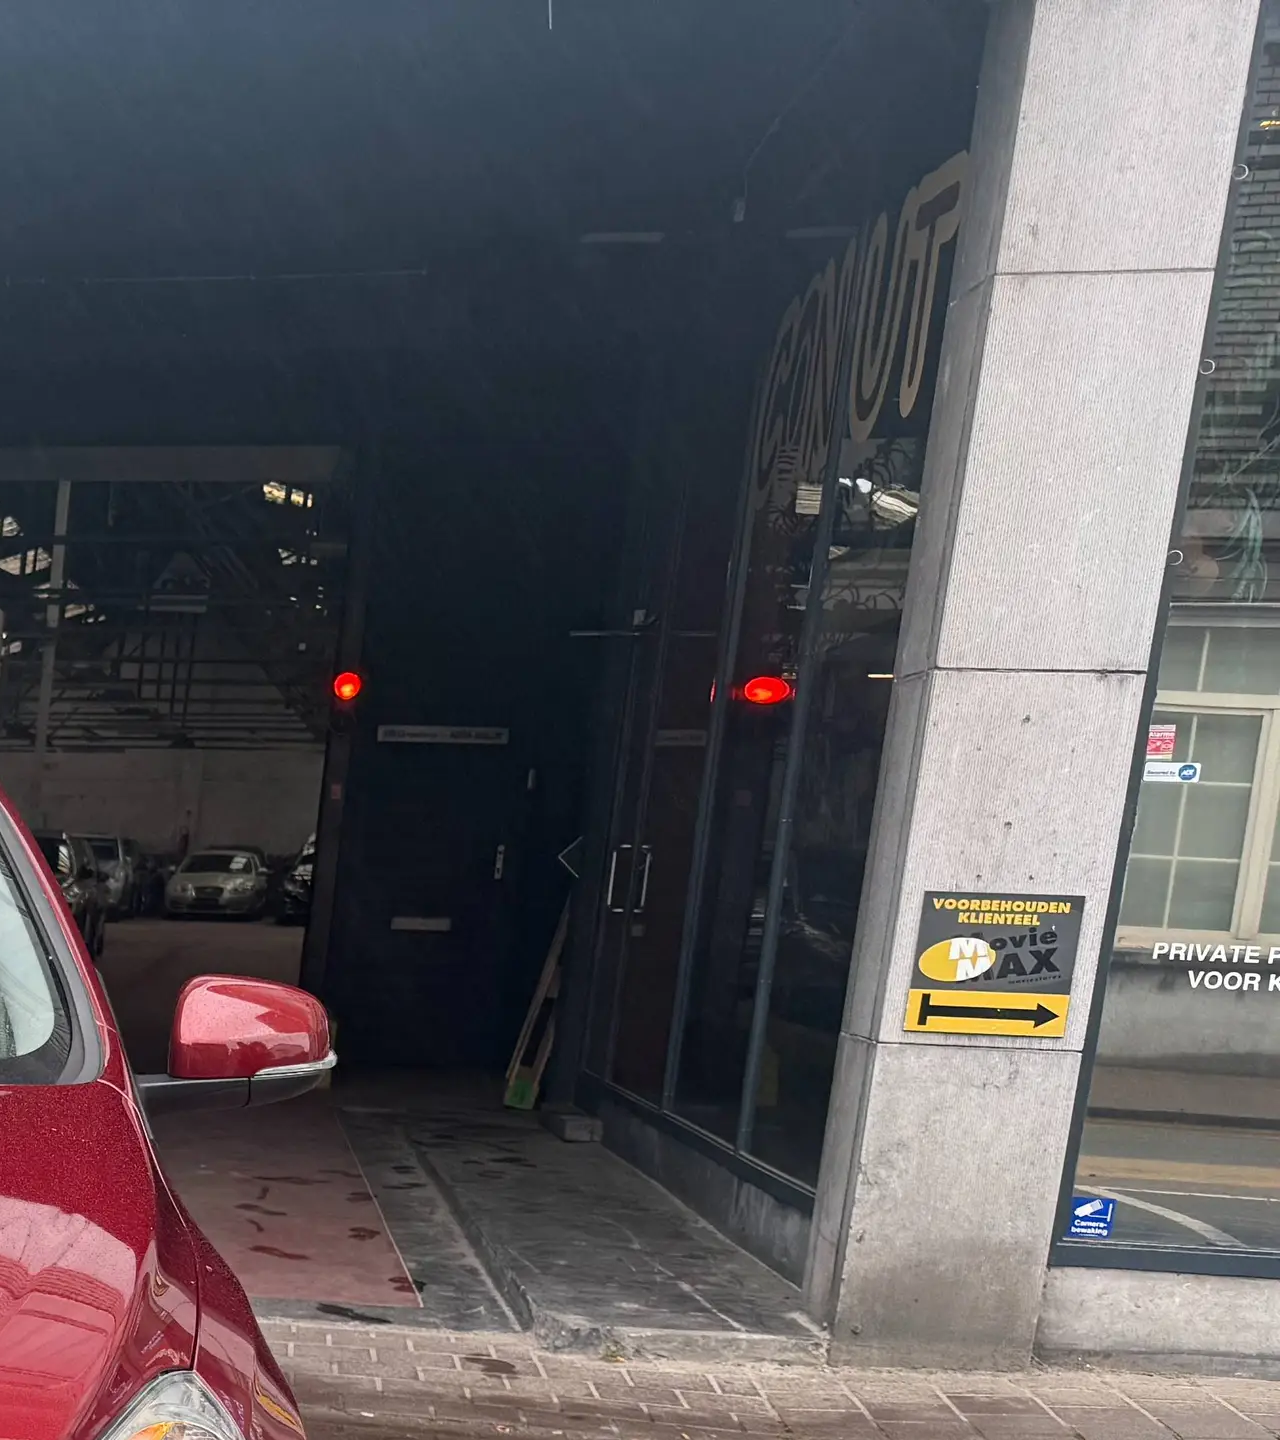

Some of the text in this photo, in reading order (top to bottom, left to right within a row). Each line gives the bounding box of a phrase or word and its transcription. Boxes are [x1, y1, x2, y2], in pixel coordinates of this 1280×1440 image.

[932, 898, 1072, 914] VOORBEHOUDEN
[957, 912, 1041, 926] KLIENTEEL
[1152, 942, 1262, 964] PRIVATE
[955, 947, 1060, 983] MAX
[1188, 970, 1262, 991] VOOR
[1074, 1219, 1107, 1228] Camera-
